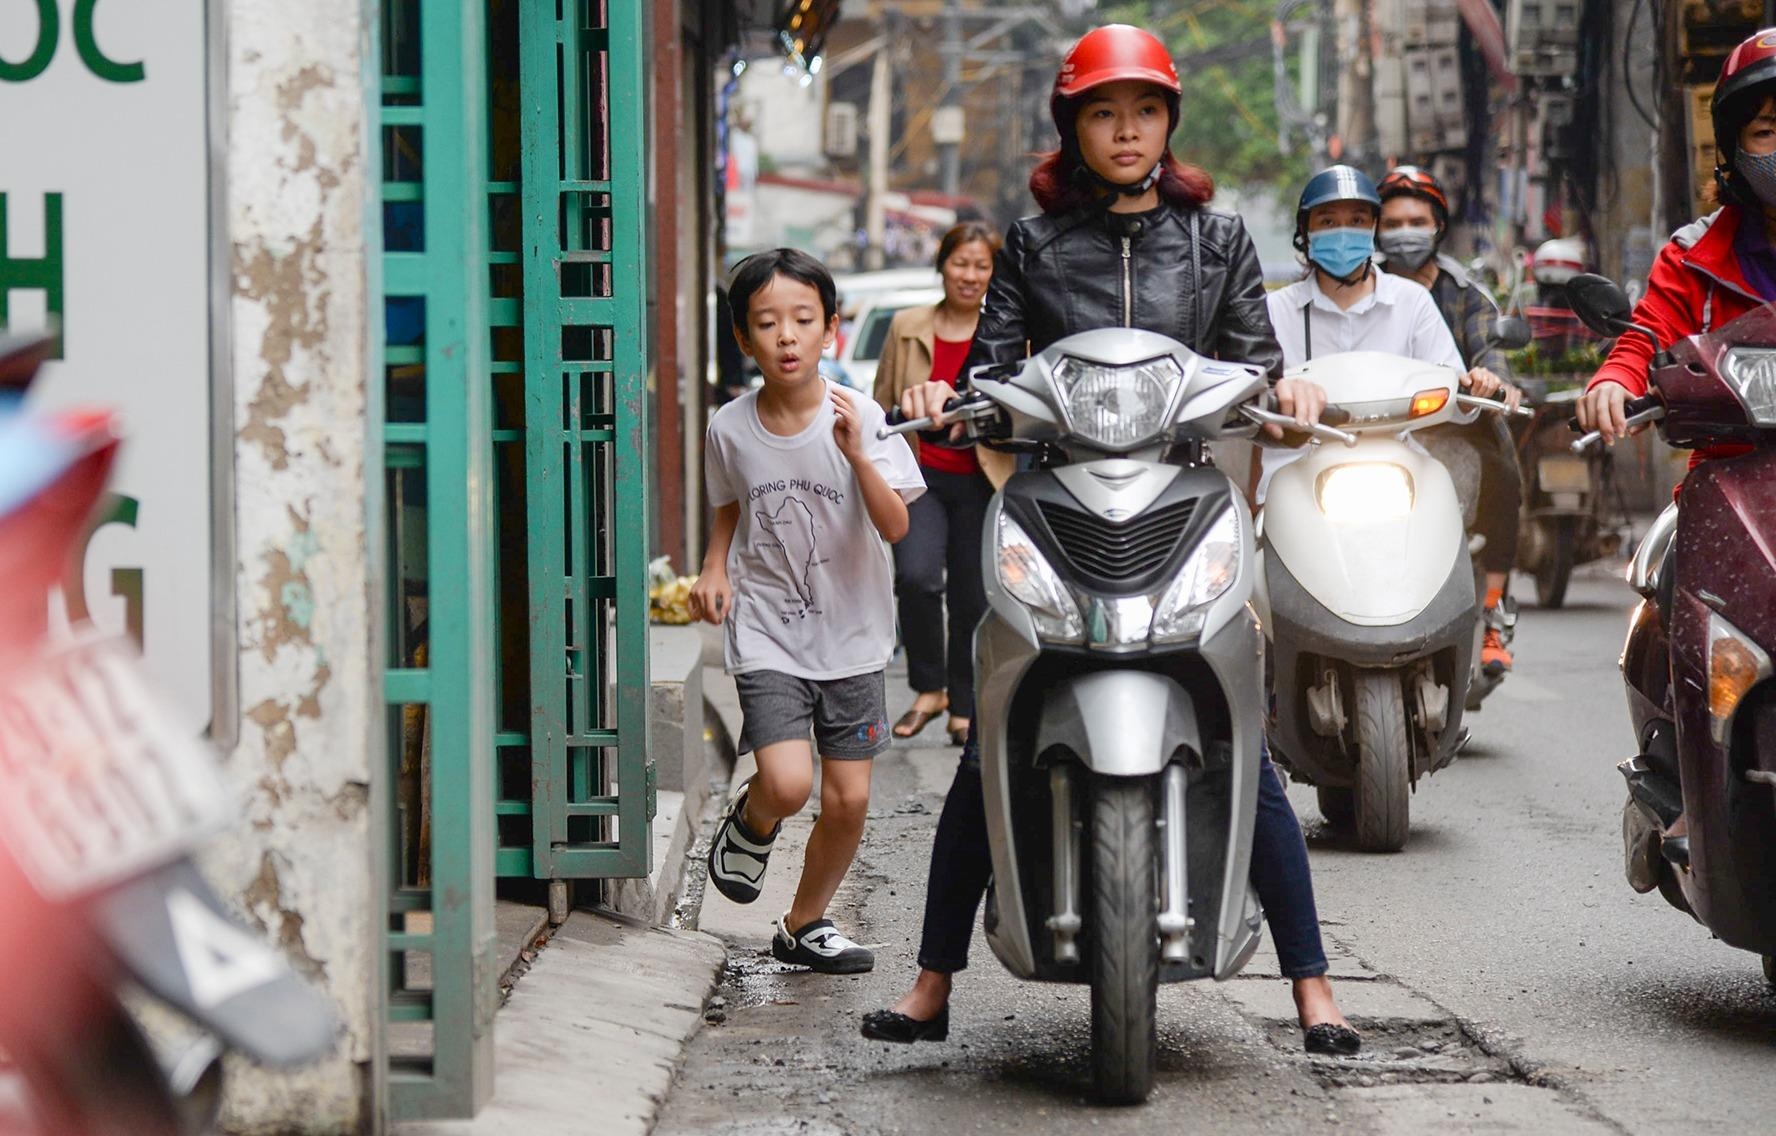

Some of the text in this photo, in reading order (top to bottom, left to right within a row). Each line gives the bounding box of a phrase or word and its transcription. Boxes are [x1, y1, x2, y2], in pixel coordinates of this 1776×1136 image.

[746, 479, 845, 505] LORING PHU QUOC
